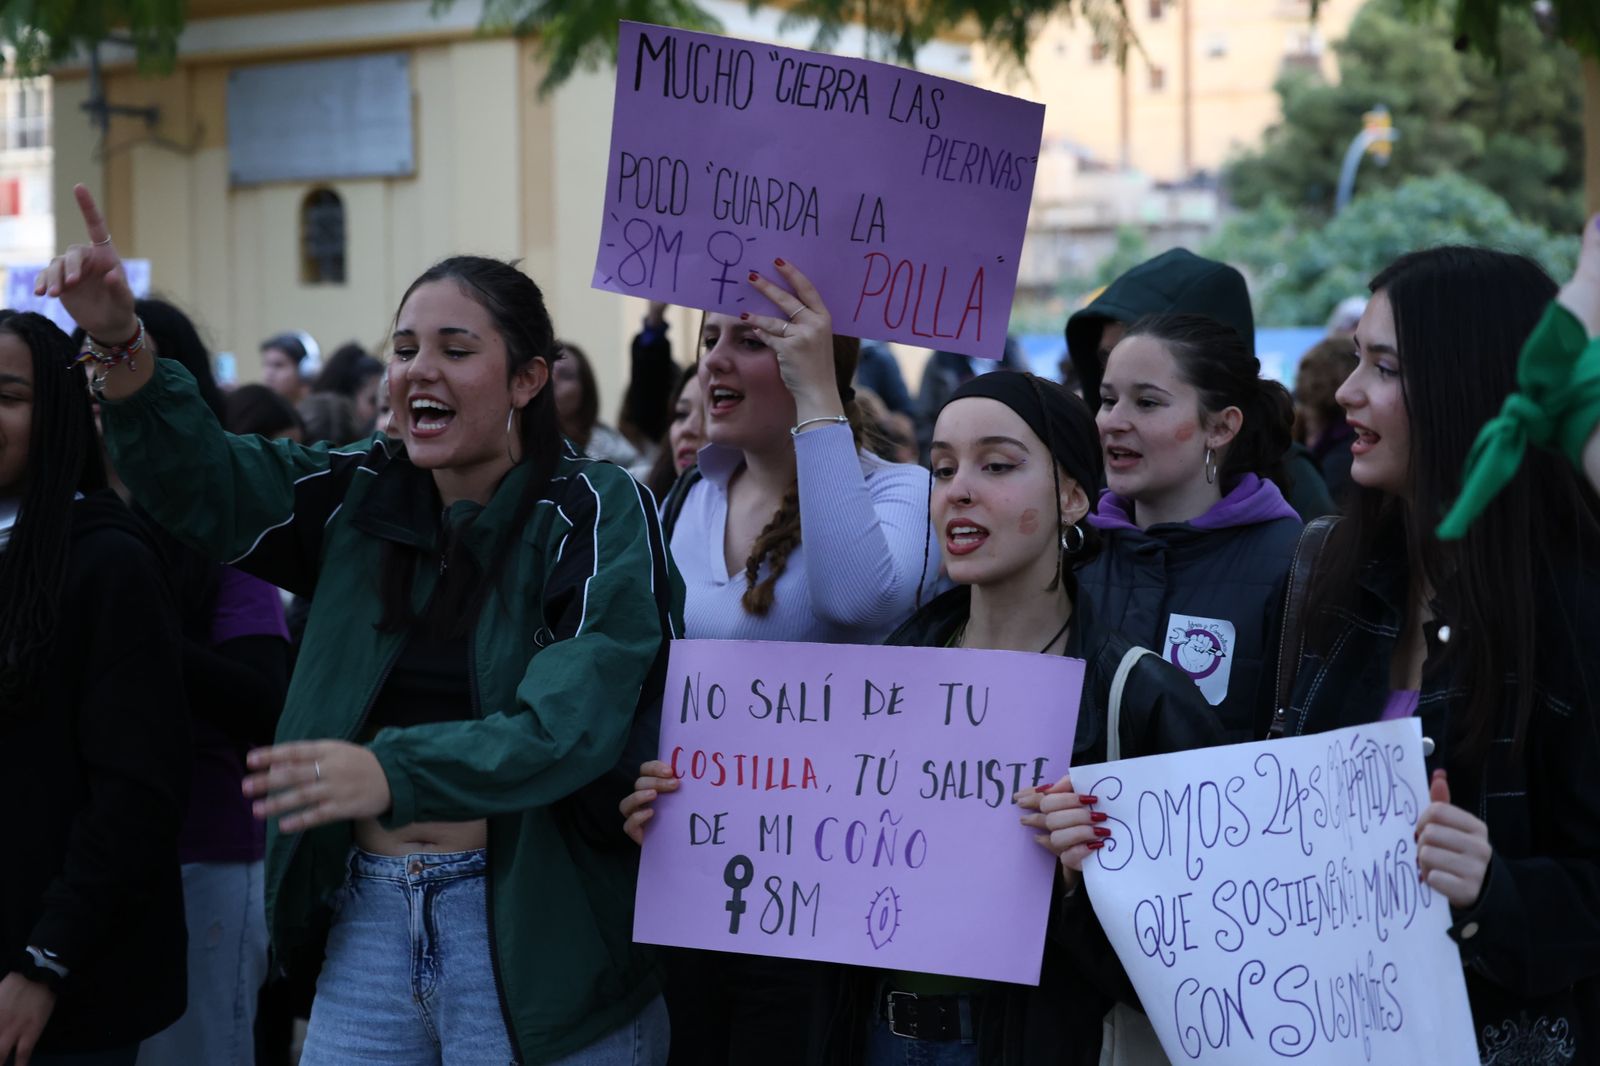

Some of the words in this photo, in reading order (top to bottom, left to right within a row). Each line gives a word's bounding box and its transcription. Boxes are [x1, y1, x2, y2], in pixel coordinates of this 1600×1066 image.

[635, 33, 755, 110] MUCHO
[768, 51, 870, 115] "CIERRA
[888, 78, 945, 129] LAS
[618, 152, 689, 216] POCO
[706, 161, 819, 237] "GUARDA
[850, 193, 886, 244] LA
[921, 134, 1038, 192] PIERNAS"
[617, 218, 683, 292] 8M
[853, 252, 1004, 342] POLLA"
[680, 672, 727, 724] NO
[748, 673, 833, 724] SALÍ
[862, 680, 905, 721] DE
[939, 682, 990, 726] TU
[670, 746, 833, 793] COSTILLA,
[854, 749, 899, 796] TÚ
[690, 812, 729, 846] DE
[759, 814, 793, 855] MI
[814, 809, 927, 869] COÑO
[1089, 775, 1250, 881] SOMOS
[759, 875, 821, 937] 8M
[1134, 893, 1199, 967] QUE
[1174, 960, 1266, 1059] CON
